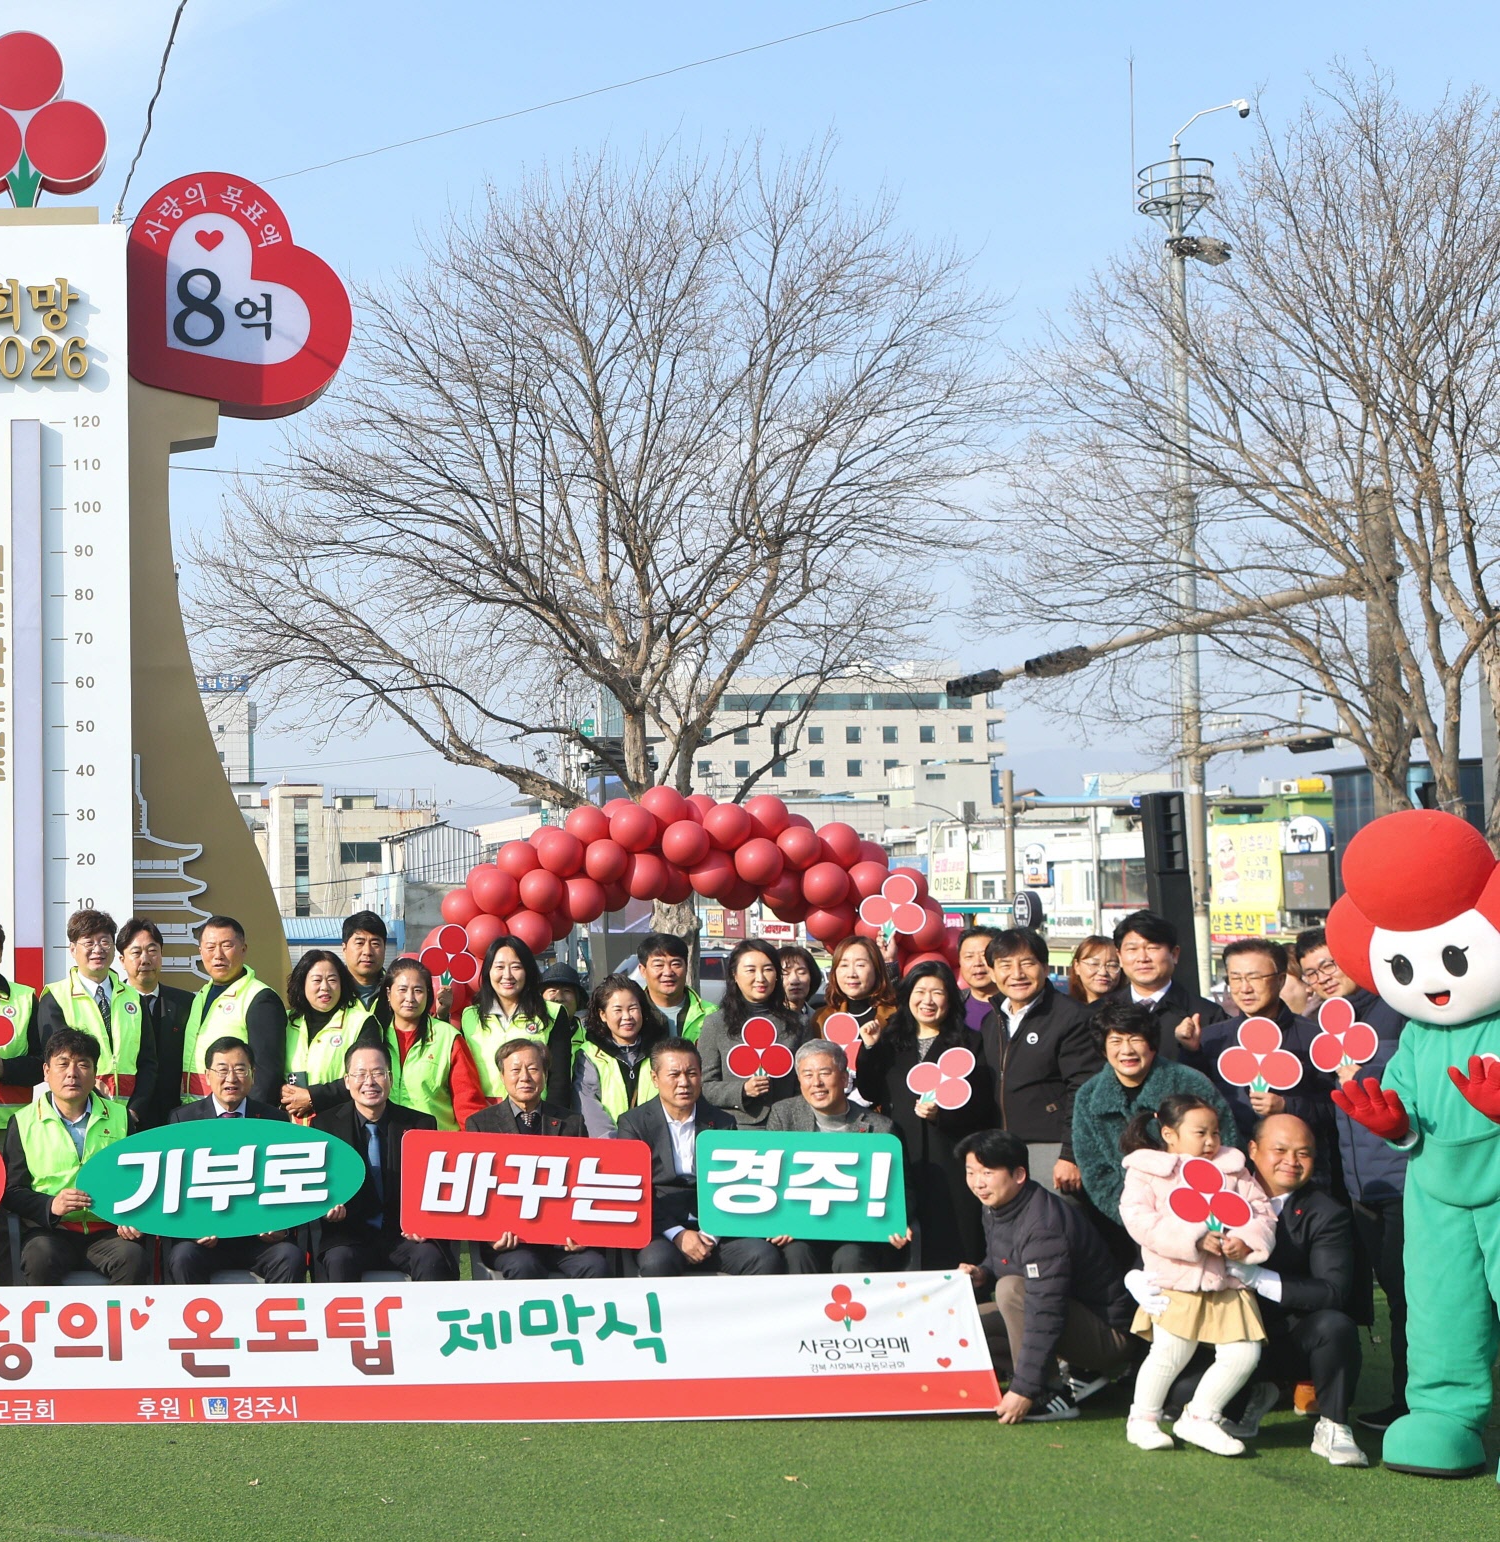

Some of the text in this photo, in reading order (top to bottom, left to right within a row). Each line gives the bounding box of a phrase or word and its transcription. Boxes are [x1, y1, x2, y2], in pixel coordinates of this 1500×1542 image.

[145, 182, 283, 248] 사랑의 목표액
[172, 268, 273, 347] 8억
[72, 416, 101, 428] 120
[72, 460, 101, 471] 110
[73, 502, 102, 513] 100
[74, 545, 94, 556] 90
[74, 588, 94, 600] 80
[74, 633, 95, 644] 70
[74, 676, 95, 688] 60
[75, 720, 95, 732] 50
[75, 765, 96, 776] 40
[75, 809, 96, 820] 30
[76, 853, 96, 865] 20
[77, 898, 95, 909] 10
[1211, 912, 1256, 932] 삼촌축산
[113, 1140, 331, 1215] 기부로
[706, 1148, 892, 1218] 경주!
[419, 1150, 644, 1224] 바꾸는
[169, 1296, 403, 1378] 온도탑
[436, 1291, 668, 1366] 제막식
[798, 1336, 911, 1361] 사랑의열매
[137, 1395, 299, 1420] 후원 경주시
